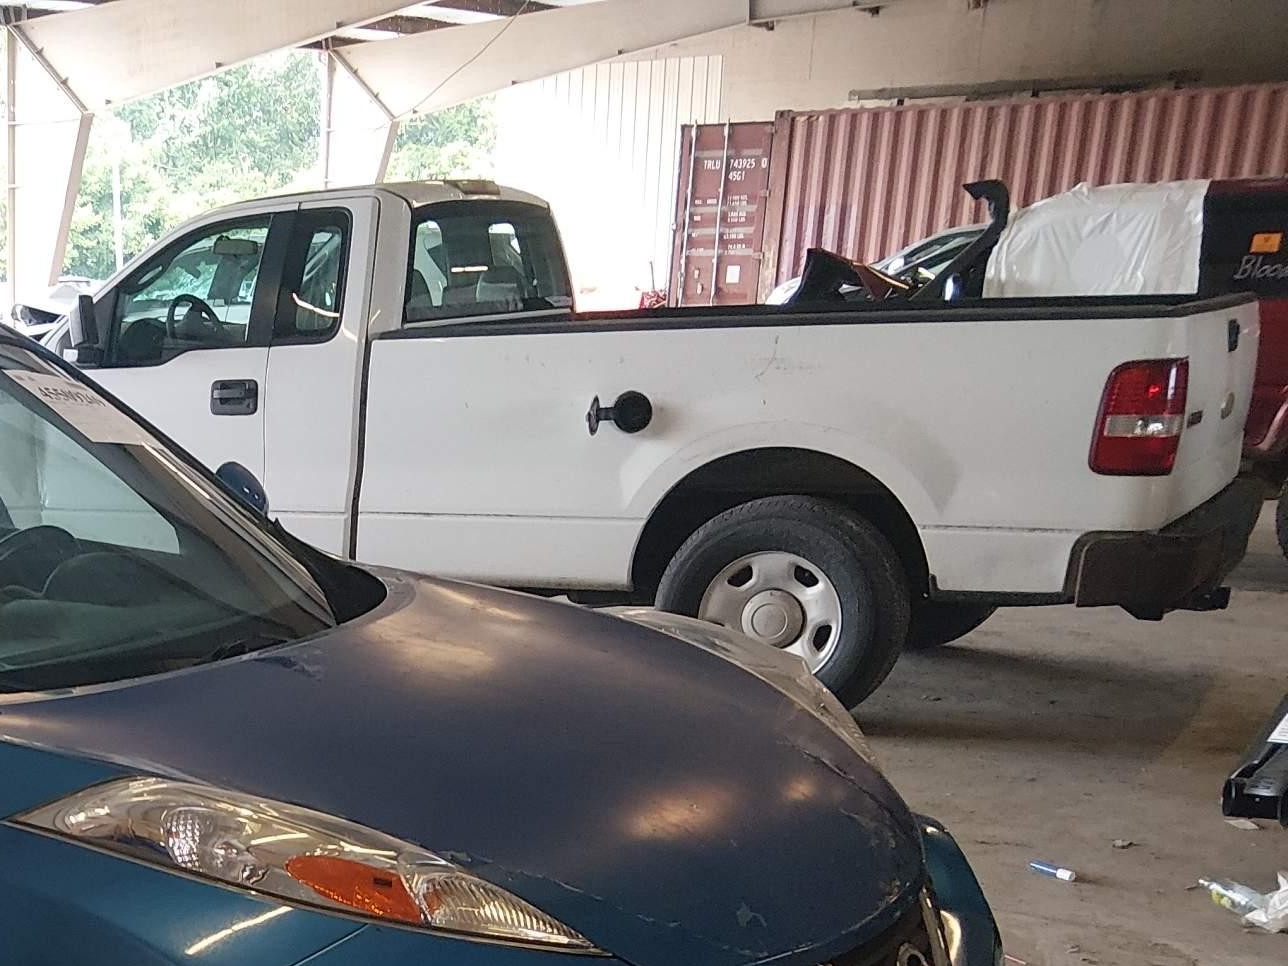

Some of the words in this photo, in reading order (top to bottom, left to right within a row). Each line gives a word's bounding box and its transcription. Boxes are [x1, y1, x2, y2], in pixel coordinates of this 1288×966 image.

[704, 159, 721, 170] TRLU
[729, 158, 756, 169] 743925
[728, 170, 746, 181] 45G1
